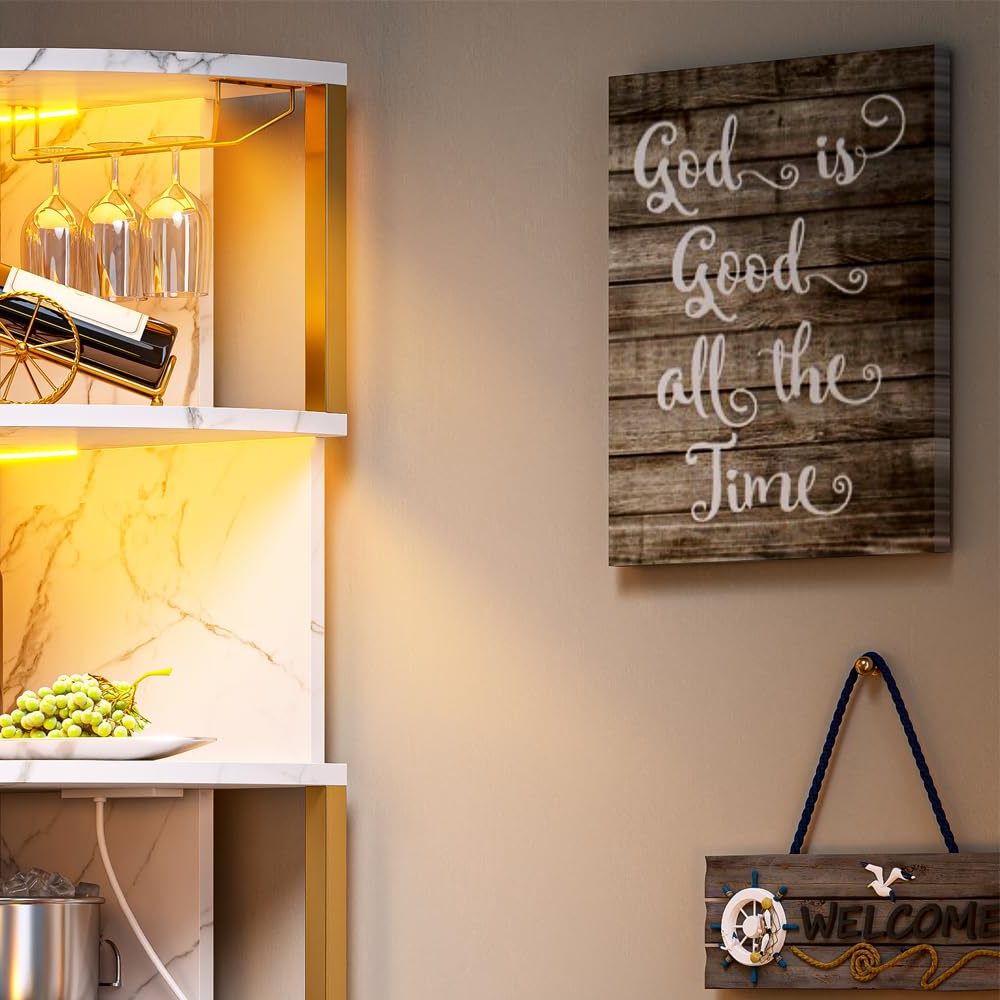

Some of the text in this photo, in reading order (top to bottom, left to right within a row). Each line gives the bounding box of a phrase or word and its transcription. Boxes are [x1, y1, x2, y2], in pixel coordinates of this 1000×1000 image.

[634, 94, 906, 216] God is
[672, 216, 868, 322] Good
[657, 320, 882, 429] all the
[685, 432, 853, 522] Time
[800, 901, 1000, 941] WELCOME
